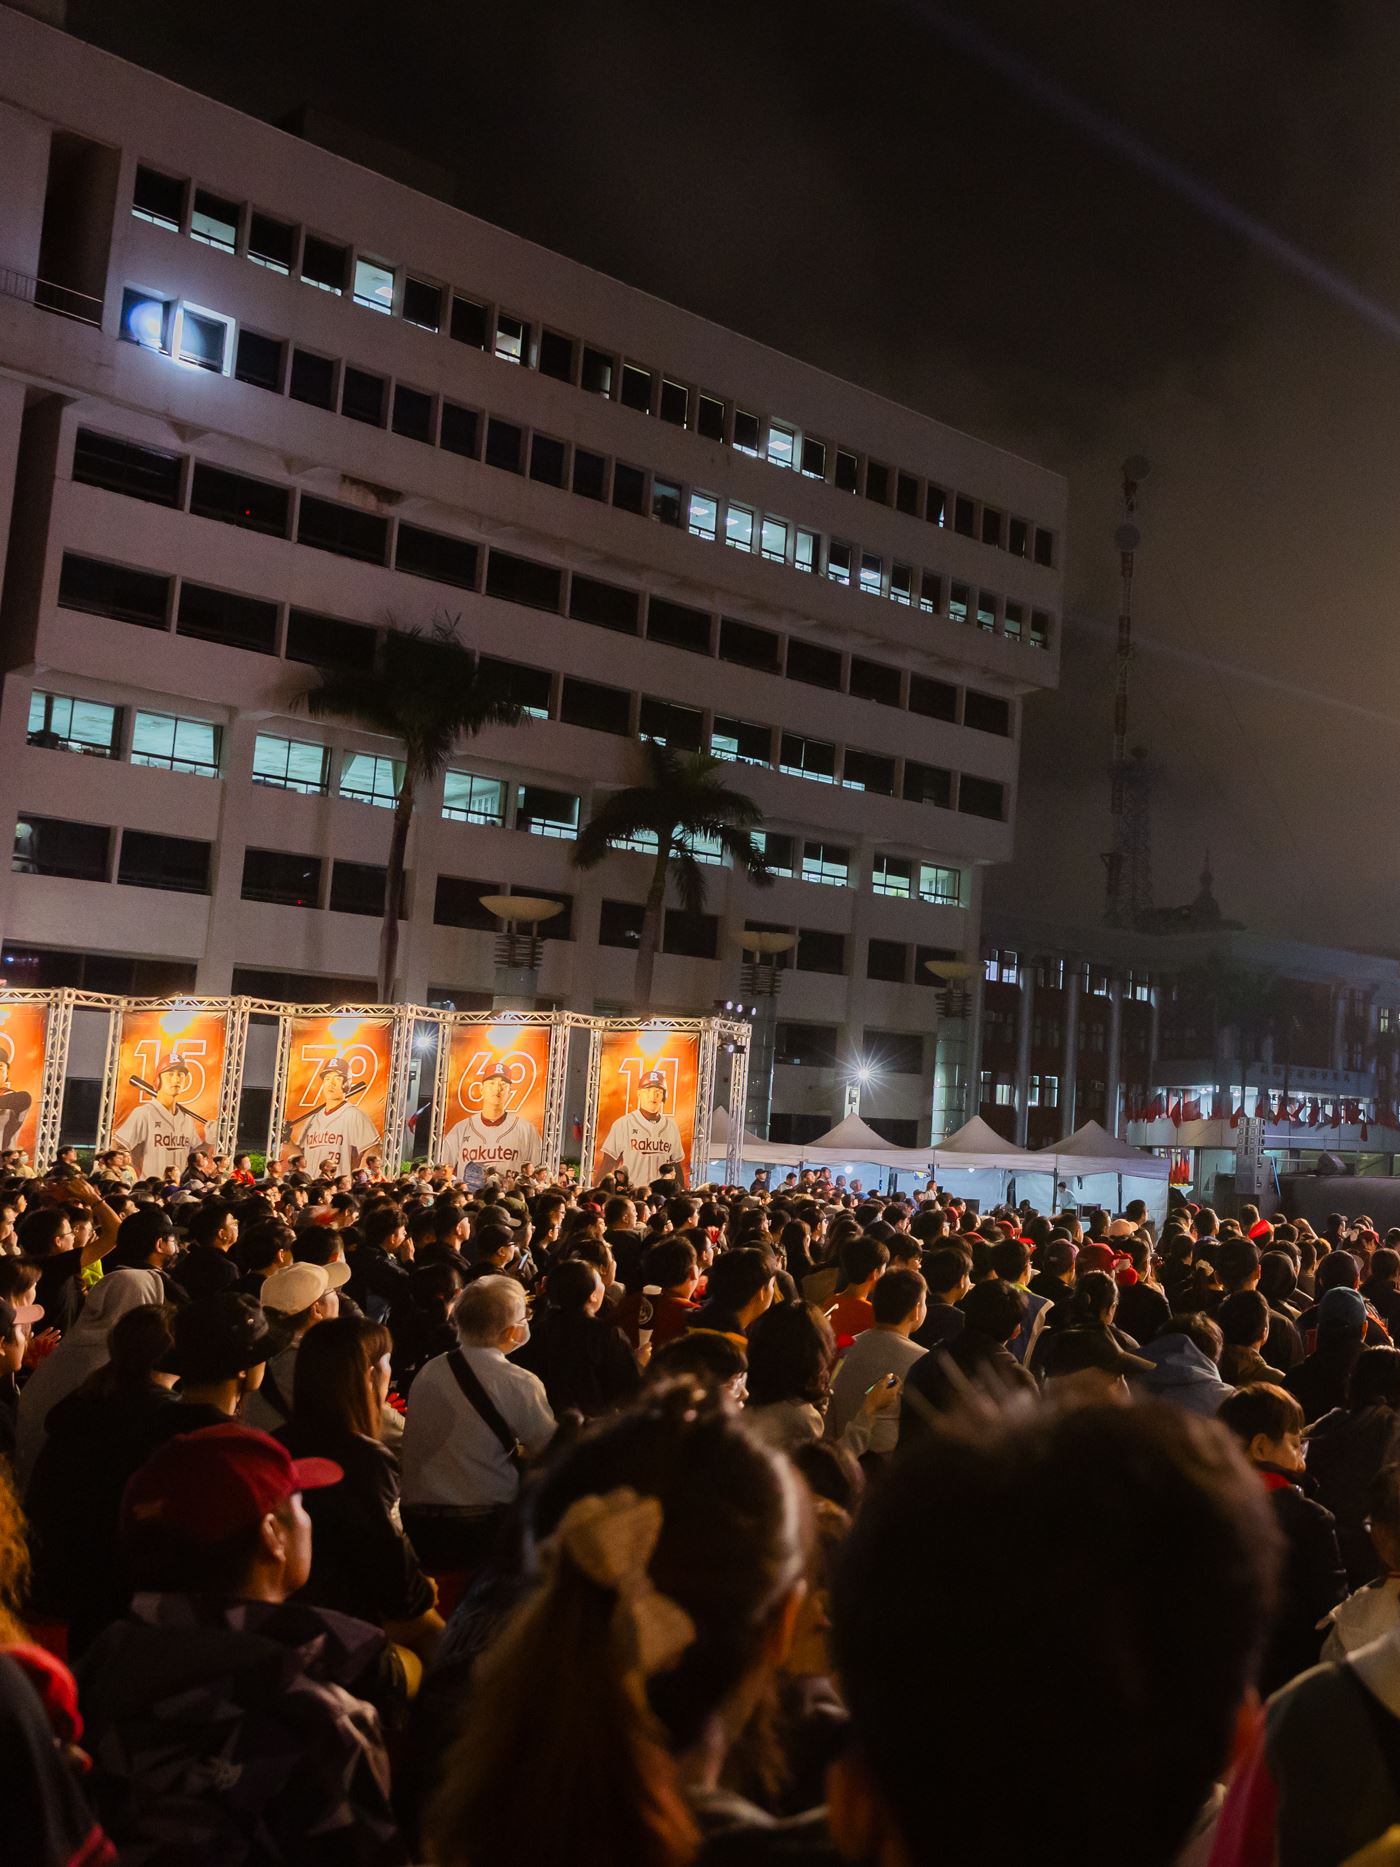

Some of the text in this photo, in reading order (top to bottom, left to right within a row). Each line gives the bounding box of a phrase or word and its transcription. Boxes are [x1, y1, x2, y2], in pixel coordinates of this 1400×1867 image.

[133, 1039, 207, 1104] 15
[299, 1043, 378, 1106] 79
[458, 1050, 537, 1114] 69
[618, 1057, 679, 1117] 11
[462, 1145, 519, 1162] Rakuten
